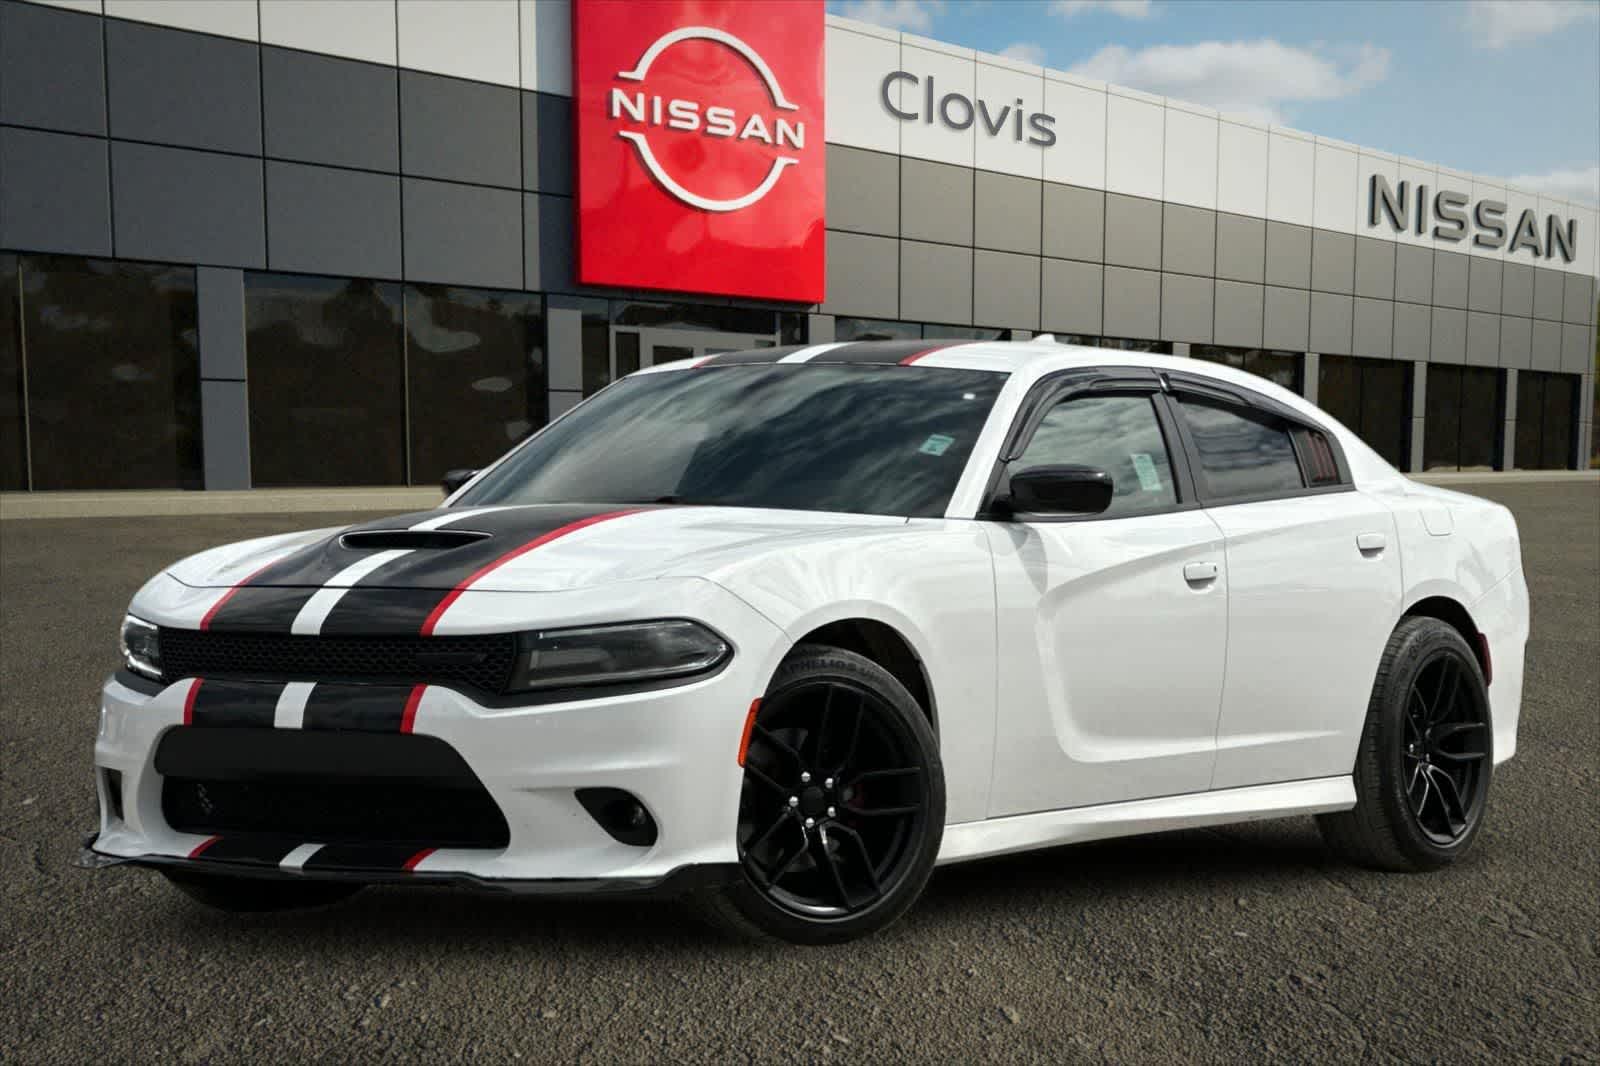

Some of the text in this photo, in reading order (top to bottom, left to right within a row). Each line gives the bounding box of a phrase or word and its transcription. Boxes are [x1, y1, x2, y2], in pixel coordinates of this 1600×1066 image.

[611, 87, 805, 149] NISSAN
[880, 70, 1057, 148] Clovis
[1368, 173, 1578, 264] NISSAN
